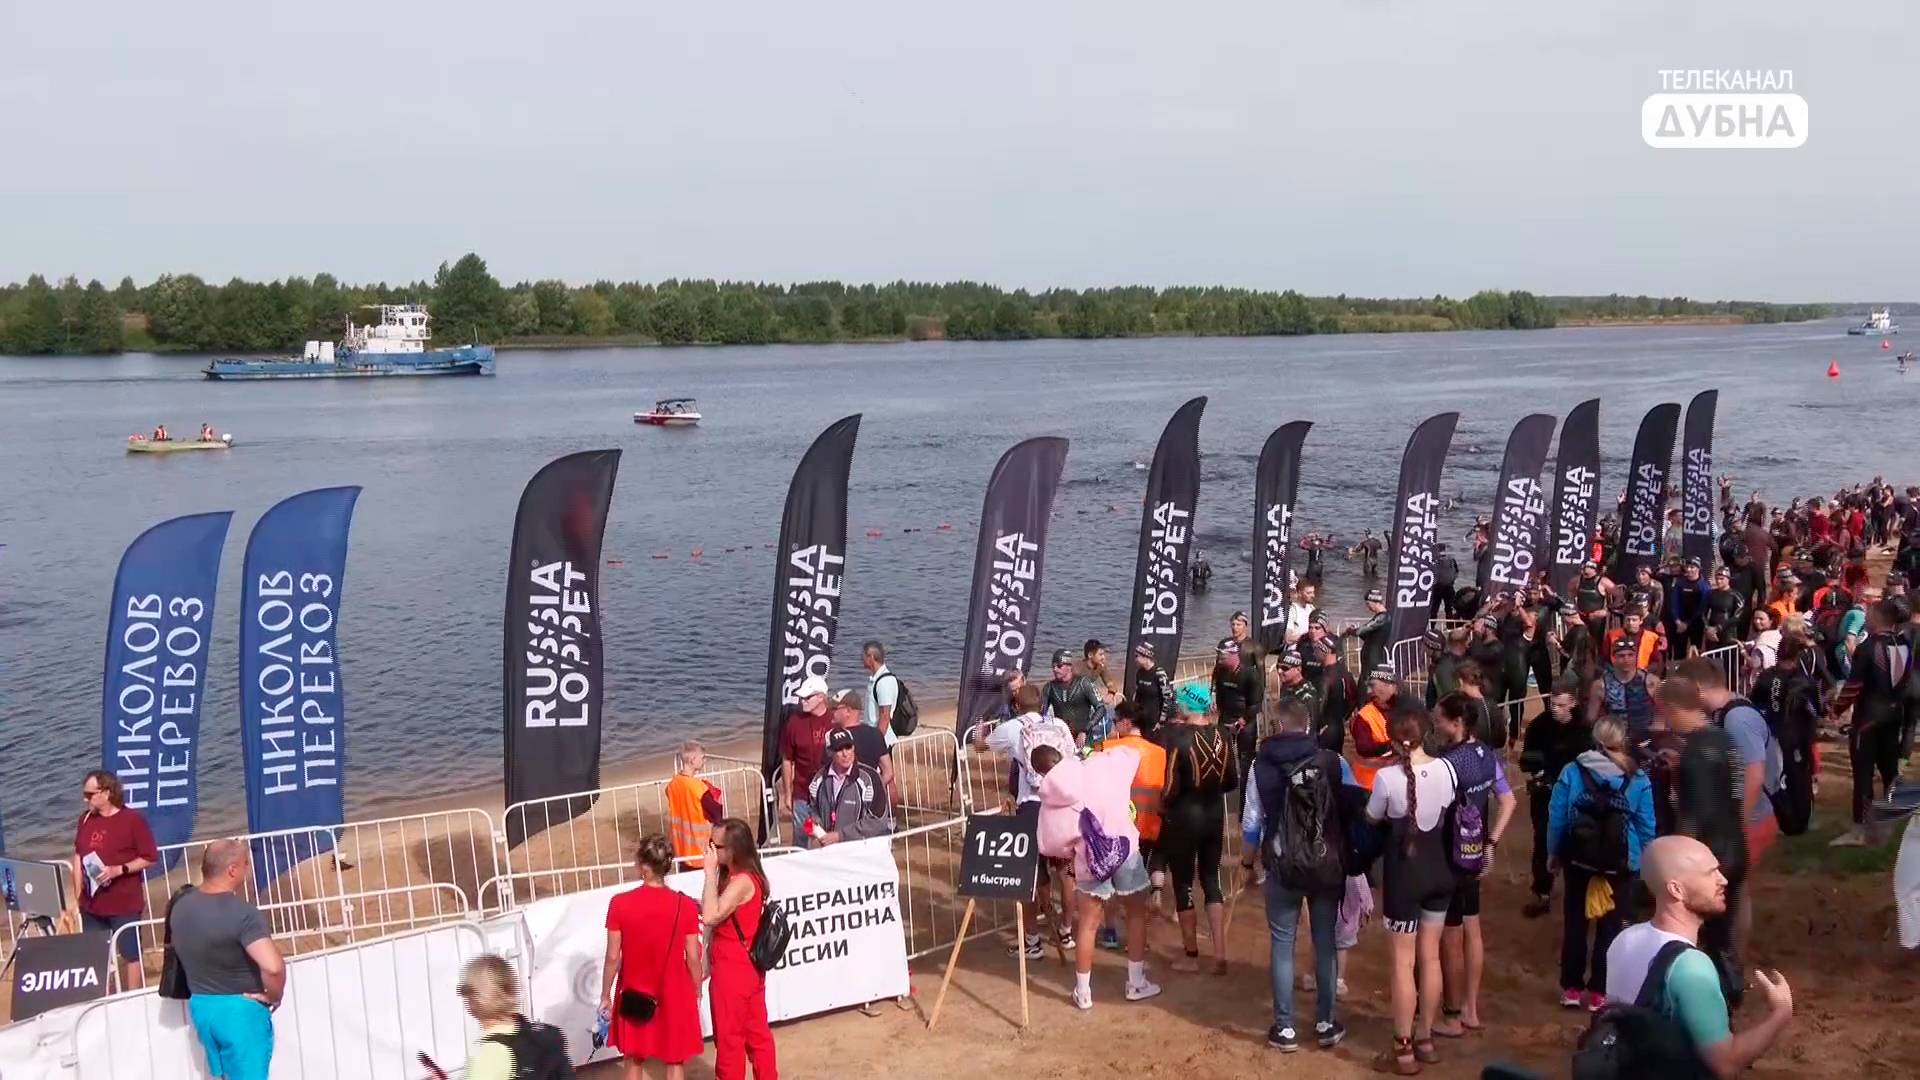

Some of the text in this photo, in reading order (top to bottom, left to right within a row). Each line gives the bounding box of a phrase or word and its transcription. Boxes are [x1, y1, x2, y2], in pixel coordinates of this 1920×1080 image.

[1141, 501, 1170, 635] RUSSIA
[1154, 501, 1190, 636] LOPPET
[1397, 492, 1426, 608] RUSSIA
[1490, 478, 1530, 584] RUSSIA
[1510, 478, 1545, 587] LOPPET
[1556, 466, 1582, 564] RUSSIA
[1572, 466, 1596, 565] LOPPET
[526, 560, 563, 728] RUSSIA
[559, 561, 592, 727] LOPPET
[782, 544, 818, 706] RUSSIA
[805, 544, 846, 681] OPPET
[980, 532, 1019, 676] RUSSIA
[116, 593, 163, 809] НИКОЛОВ
[156, 596, 204, 808] ПЕРЕВОЗ
[258, 569, 298, 796] НИКОЛОВ
[299, 571, 338, 789] ПЕРЕВОЗ
[776, 881, 896, 917] ДЕРАЦИЯ
[971, 873, 1022, 888] и быстрее
[975, 831, 1030, 858] 1:20
[21, 966, 99, 993] ЭЛИТА
[774, 938, 849, 971] ОССИИ
[788, 906, 896, 940] ИАТЛОНА
